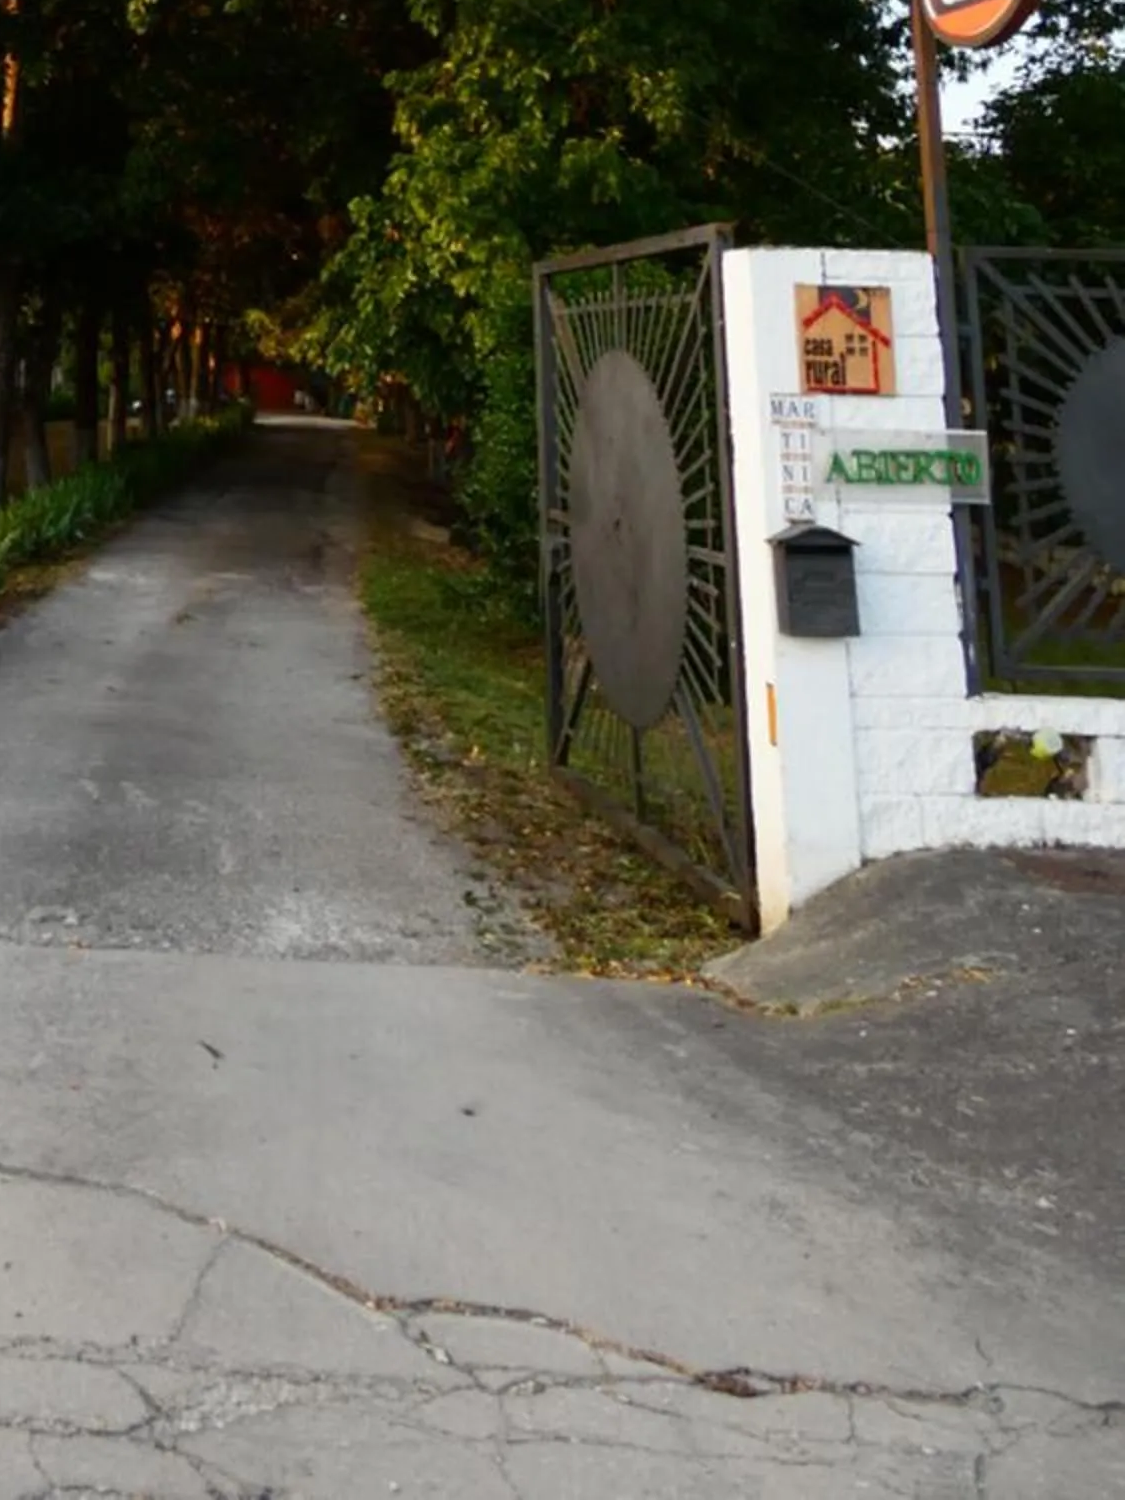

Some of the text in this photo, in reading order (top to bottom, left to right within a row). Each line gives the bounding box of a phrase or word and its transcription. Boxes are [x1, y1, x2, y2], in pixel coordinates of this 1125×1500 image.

[804, 337, 834, 356] casa
[805, 353, 847, 386] rural
[771, 400, 815, 418] MAR
[826, 449, 982, 485] ABIERTO
